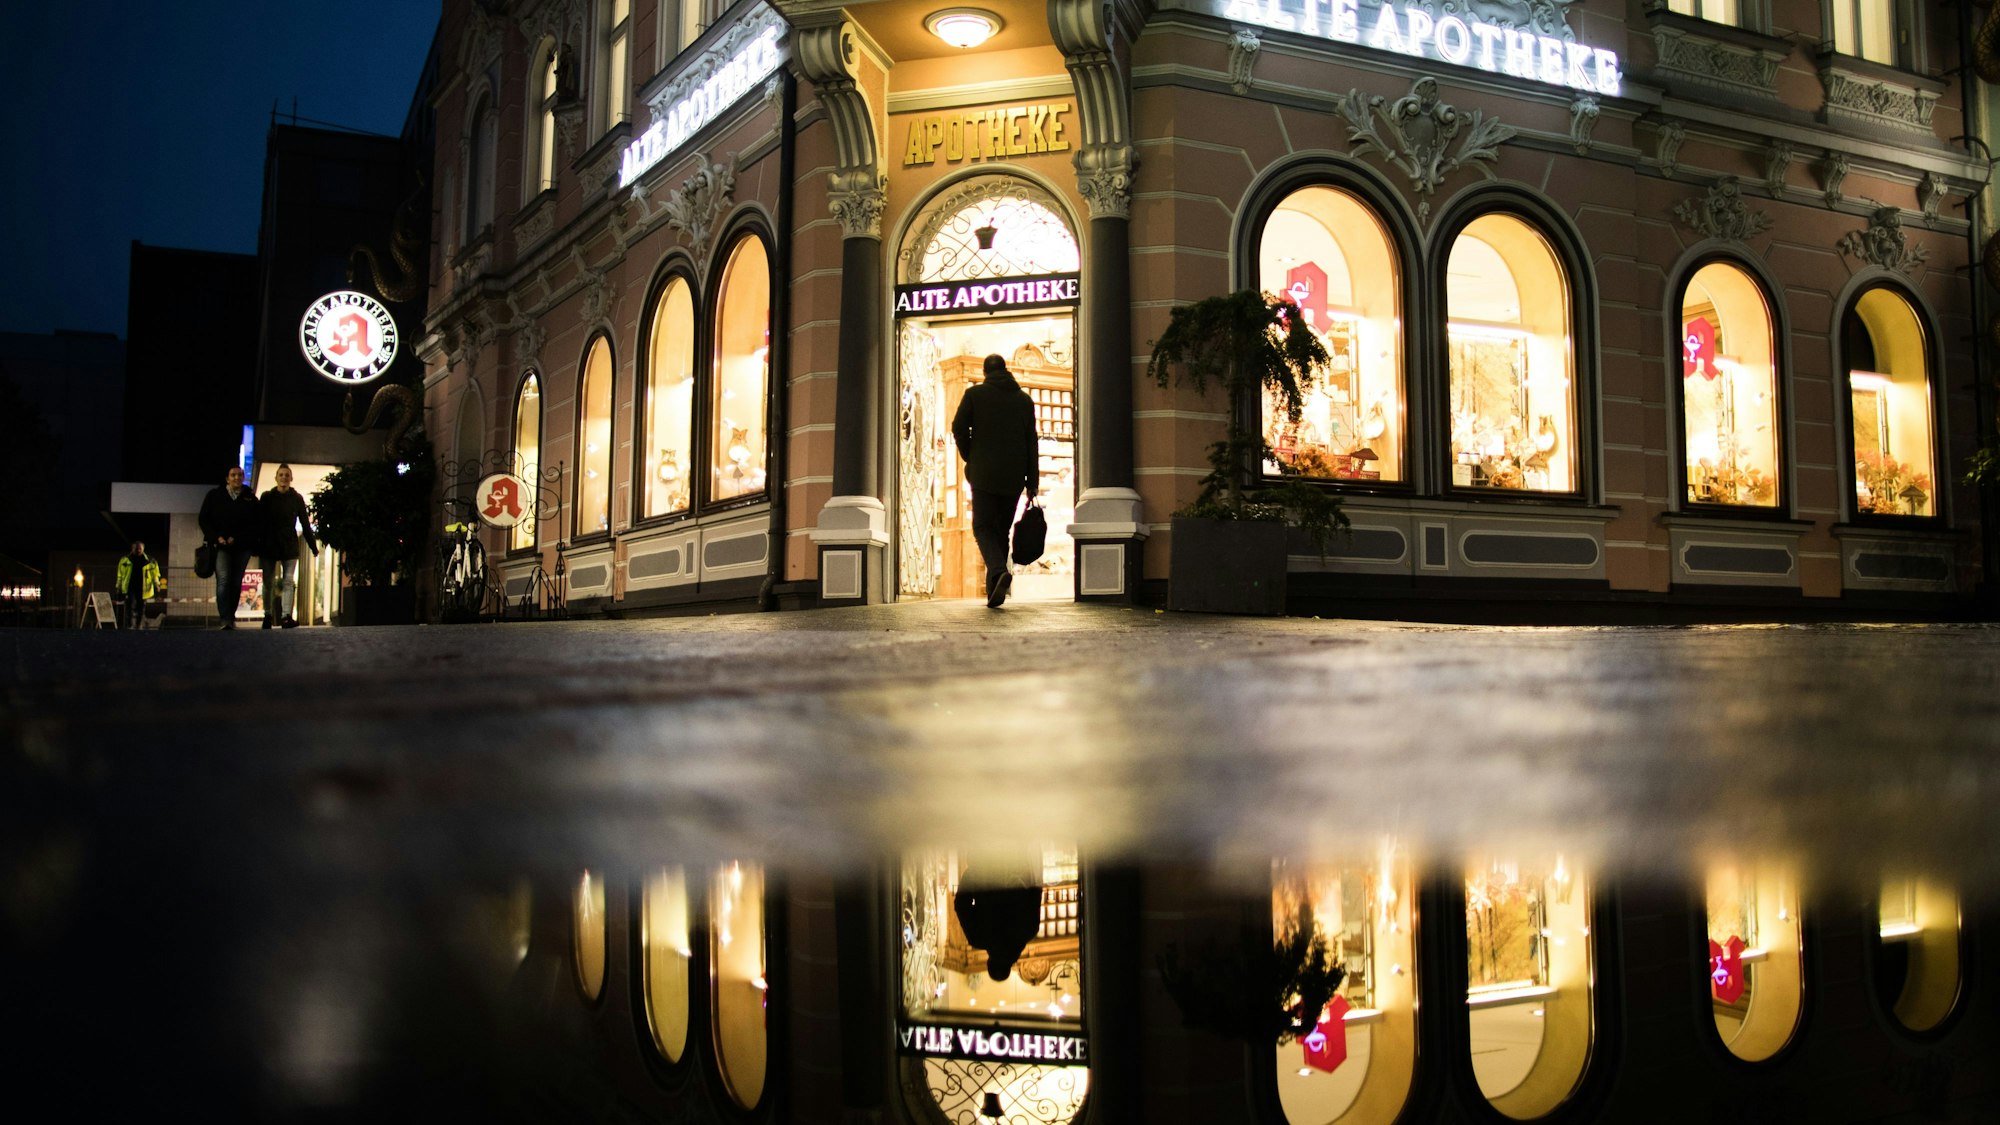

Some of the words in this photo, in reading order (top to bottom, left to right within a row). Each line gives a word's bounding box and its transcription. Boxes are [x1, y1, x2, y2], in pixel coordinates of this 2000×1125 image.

[1369, 4, 1619, 95] APOTHEKE
[620, 119, 664, 188] ALTE
[665, 25, 778, 152] APOTHEKE
[904, 103, 1070, 165] APOTHEKE
[305, 302, 329, 338] ALTE
[330, 294, 395, 343] APOTHEKE
[896, 288, 950, 312] ALTE
[952, 278, 1080, 308] APOTHEKE
[320, 360, 379, 380] 1864
[241, 573, 263, 583] 0%
